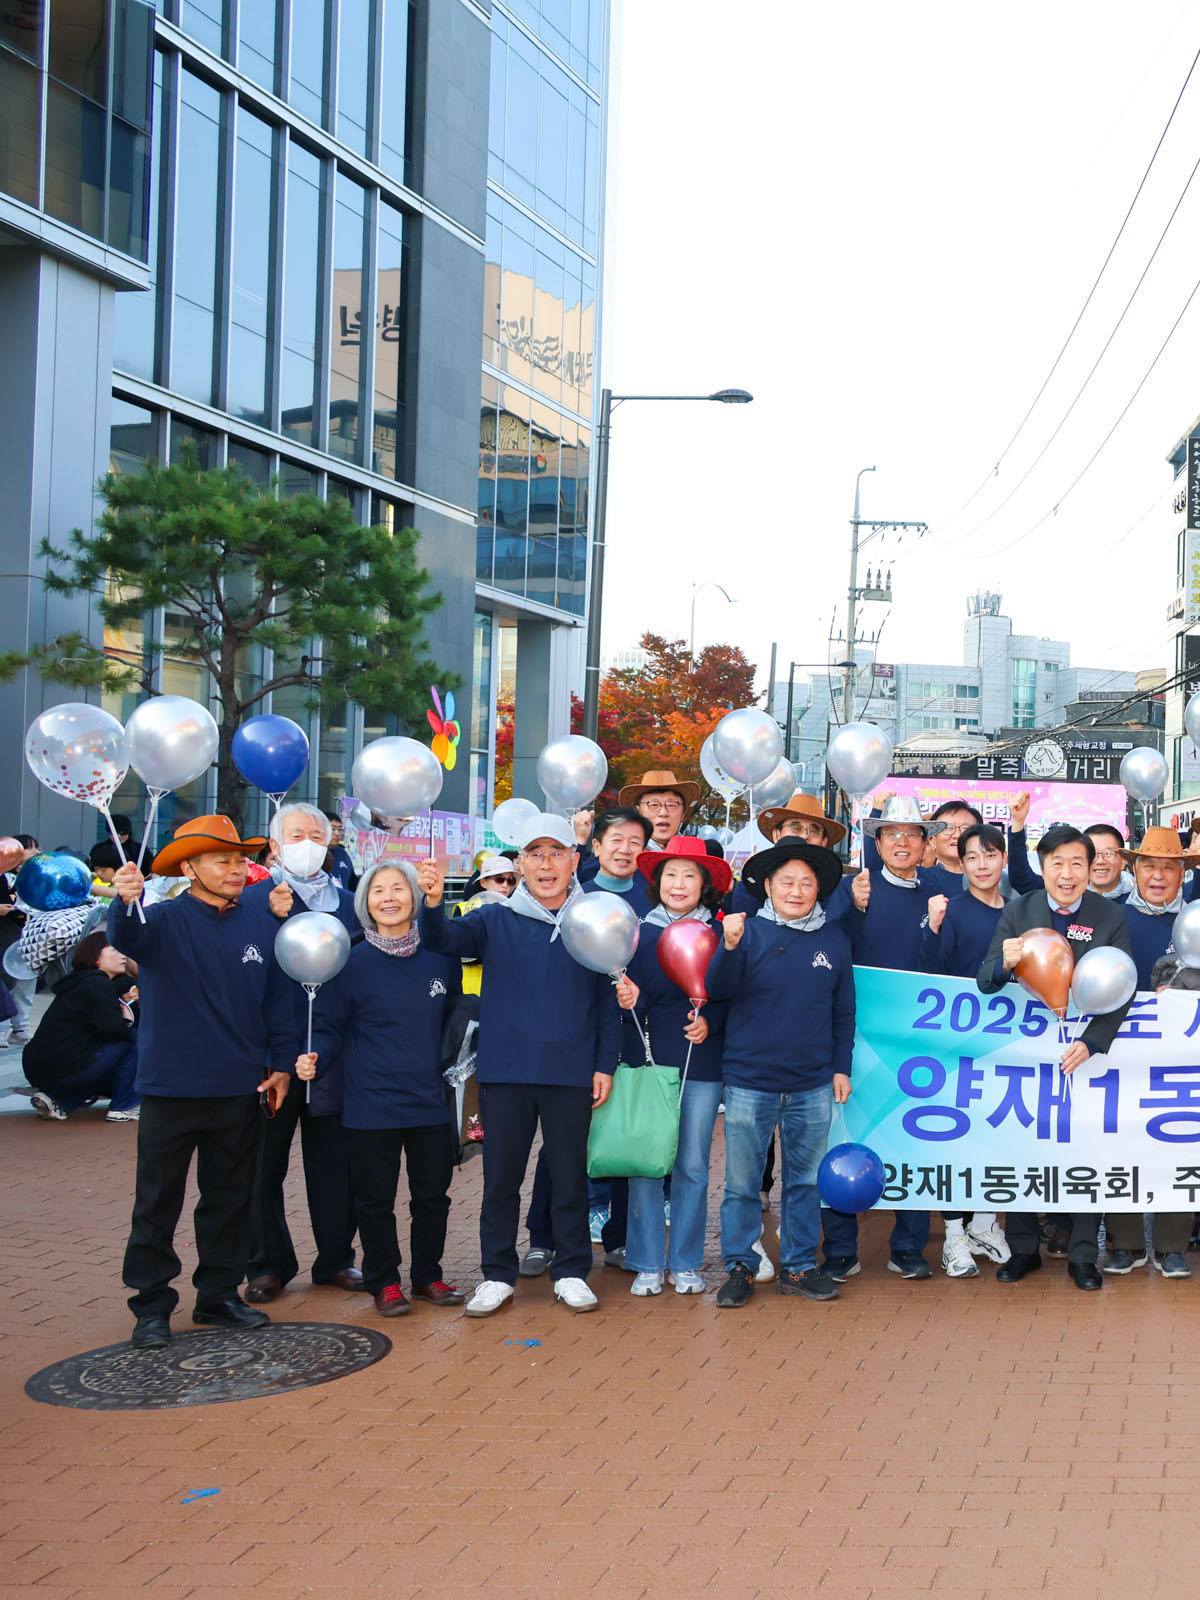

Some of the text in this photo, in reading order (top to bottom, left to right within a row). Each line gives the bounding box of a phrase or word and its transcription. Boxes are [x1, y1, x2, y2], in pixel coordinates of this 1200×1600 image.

[977, 757, 1111, 780] 말죽 거리
[1066, 928, 1093, 943] 전성수
[912, 987, 1163, 1044] 2025도
[882, 1161, 1155, 1205] 양재1동체육회,
